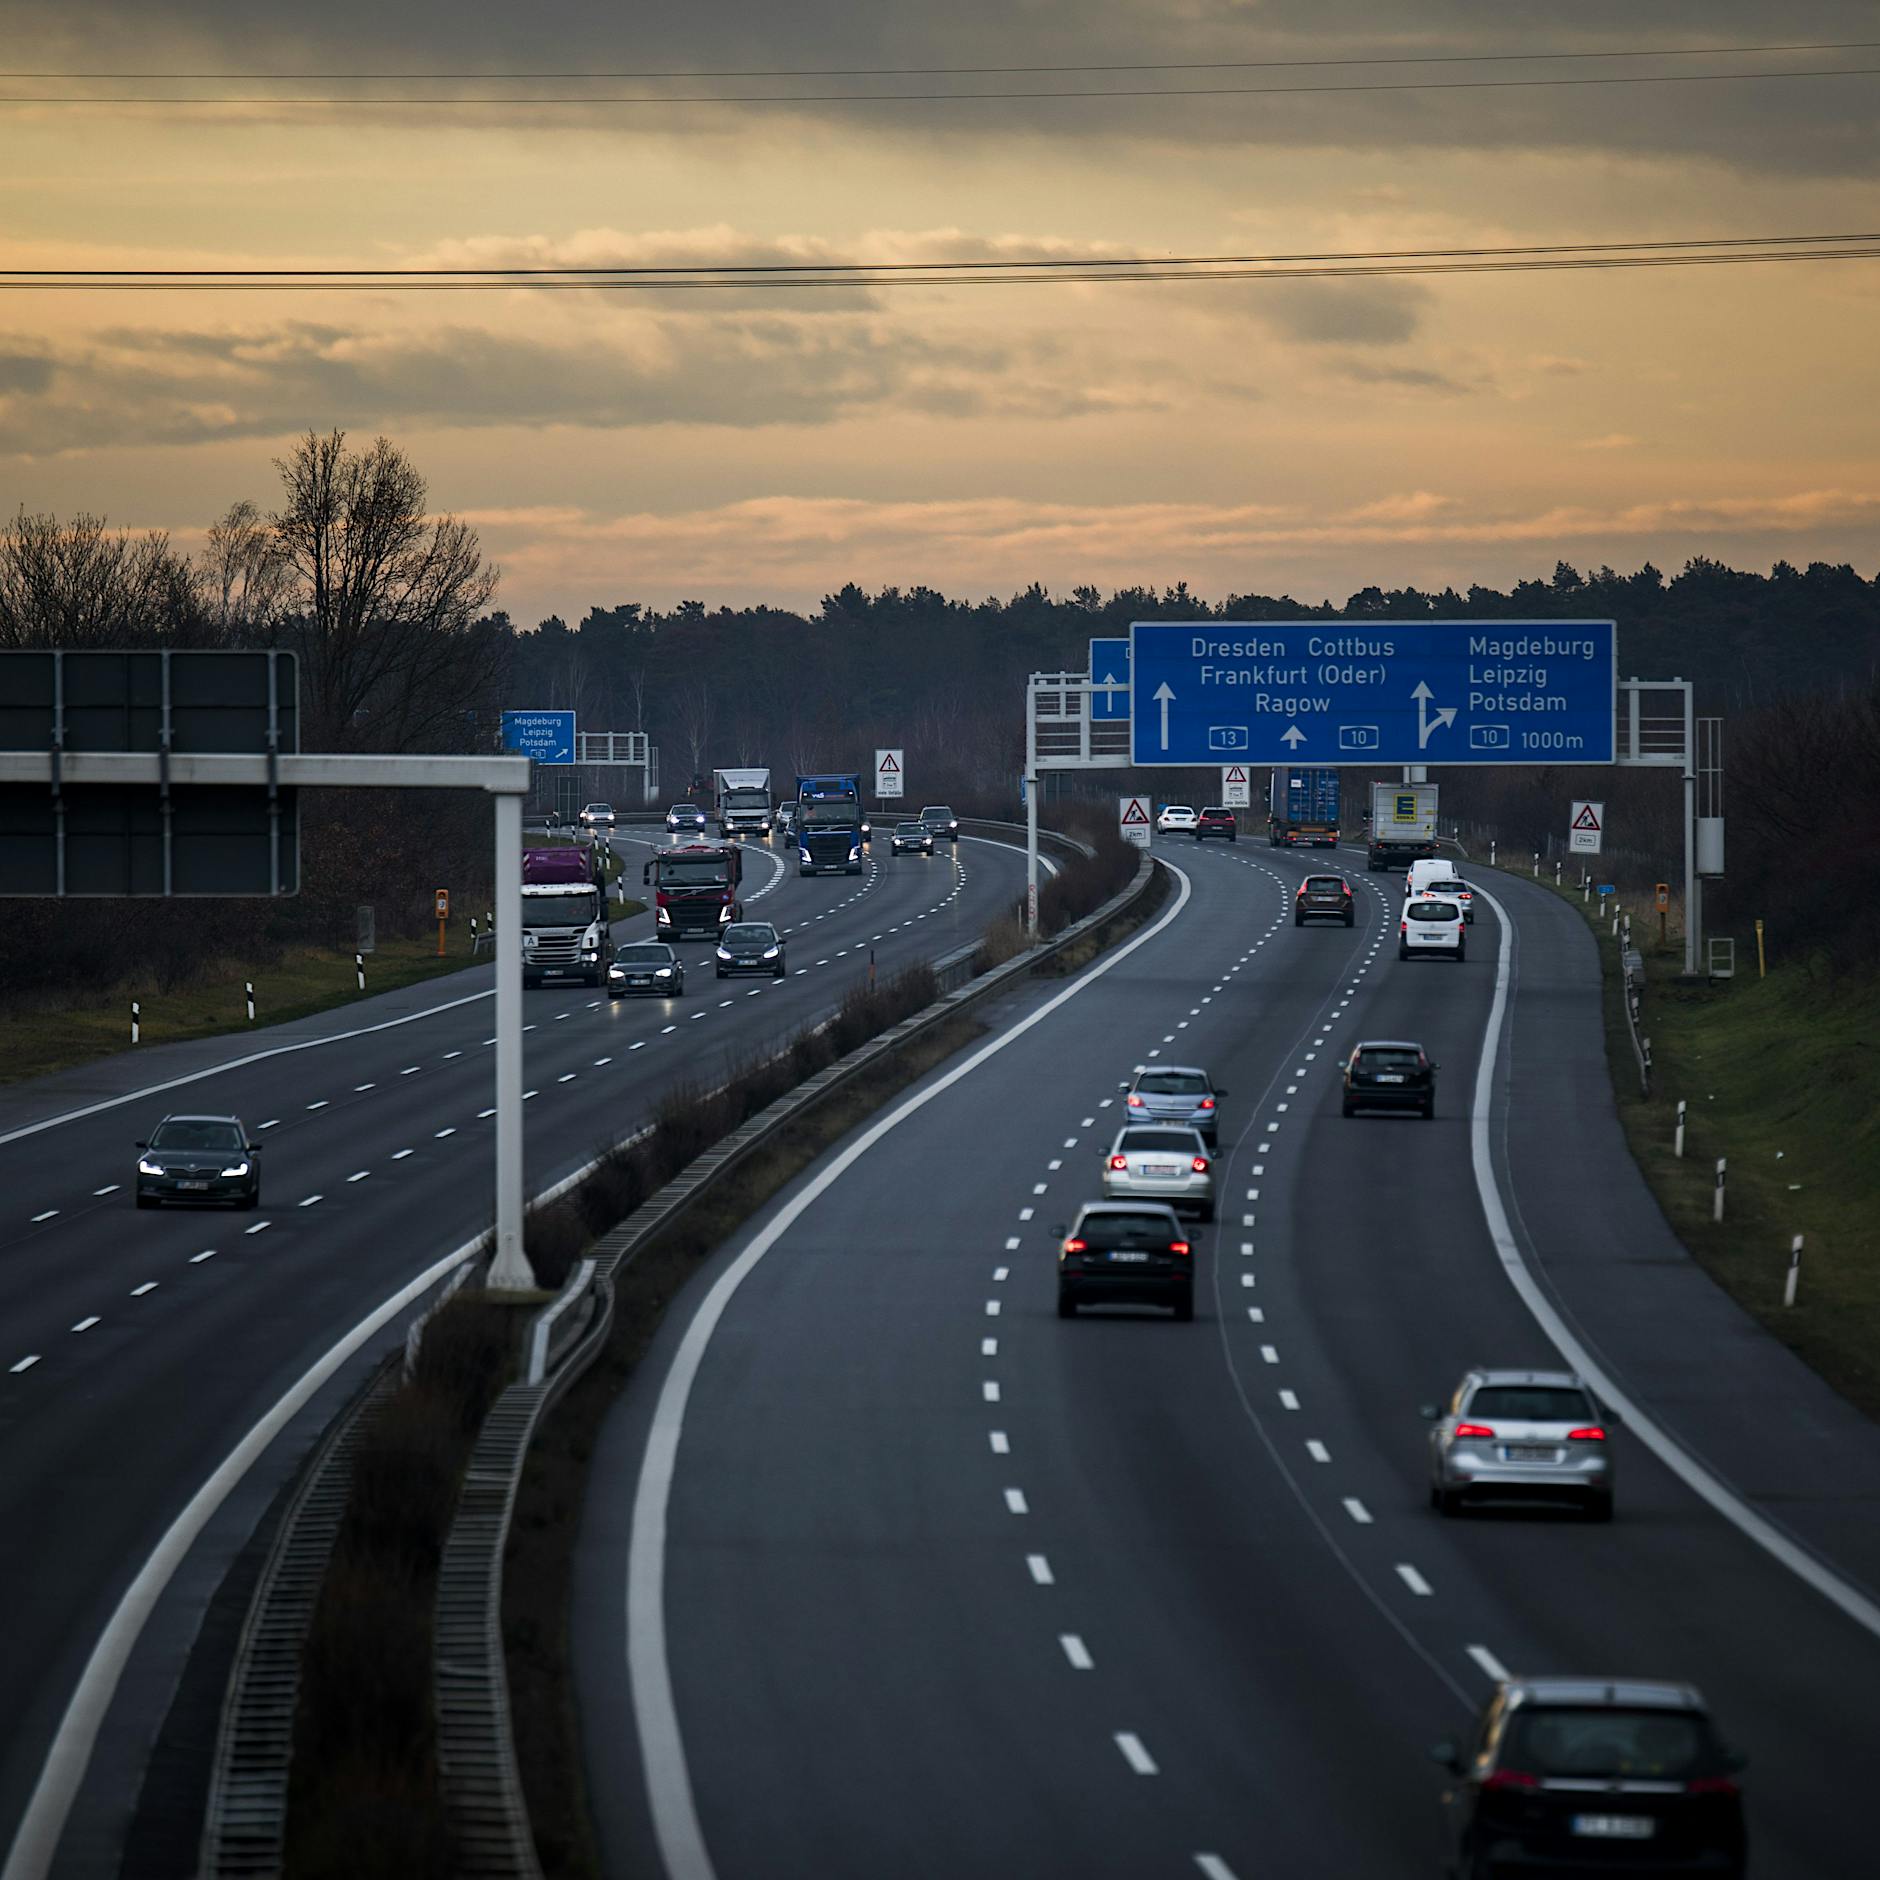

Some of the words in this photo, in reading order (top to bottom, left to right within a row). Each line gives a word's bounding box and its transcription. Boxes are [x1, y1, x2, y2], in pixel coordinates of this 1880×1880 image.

[1192, 638, 1286, 657] Dresden
[1308, 637, 1396, 656] Cottbus
[1470, 636, 1595, 660] Magdeburg
[1201, 665, 1308, 685] Frankfurt
[1318, 664, 1386, 687] (Oder)
[1470, 665, 1547, 688] Leipzig
[1256, 693, 1331, 717] Ragow
[1470, 692, 1567, 711] Potsdam
[514, 717, 562, 727] Magdeburg
[523, 727, 553, 738] Leipzig
[1221, 731, 1237, 745] 13
[1351, 730, 1367, 745] 10
[1482, 730, 1498, 744] 10
[1521, 732, 1583, 748] 1000m
[519, 738, 557, 747] Potsdam
[1397, 796, 1414, 814] E
[527, 937, 535, 946] A
